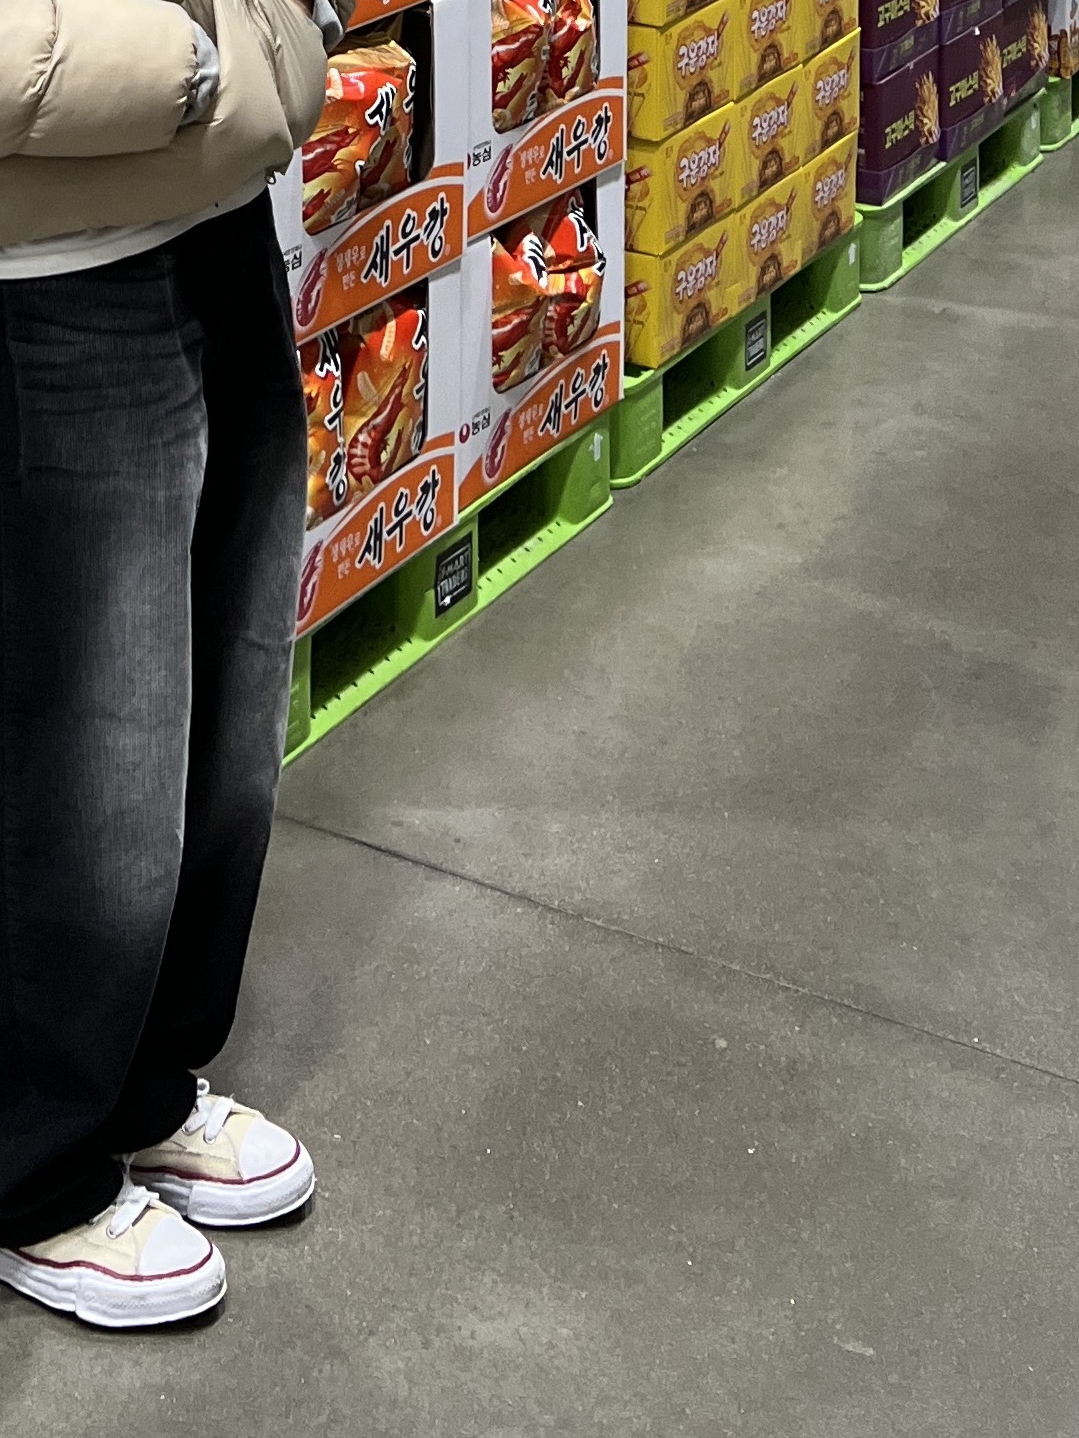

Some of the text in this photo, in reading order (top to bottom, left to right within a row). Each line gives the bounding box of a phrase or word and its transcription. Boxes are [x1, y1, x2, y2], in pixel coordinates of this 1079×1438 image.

[750, 0, 788, 39] 구운감자
[676, 36, 719, 79] 구운감자
[814, 70, 849, 107] 구운감자
[540, 102, 613, 184] 새우깡
[751, 106, 790, 144] 구운감자
[884, 110, 915, 150] 고구마스틱
[472, 145, 492, 167] 농심
[676, 144, 721, 189] 구운감자
[813, 166, 846, 208] 구운감자
[361, 191, 450, 288] 새우깡
[749, 208, 789, 253] 구운감자
[674, 255, 719, 302] 구운감자
[538, 348, 610, 438] 새우깡
[471, 412, 491, 437] 농심
[355, 464, 441, 570] 새우깡
